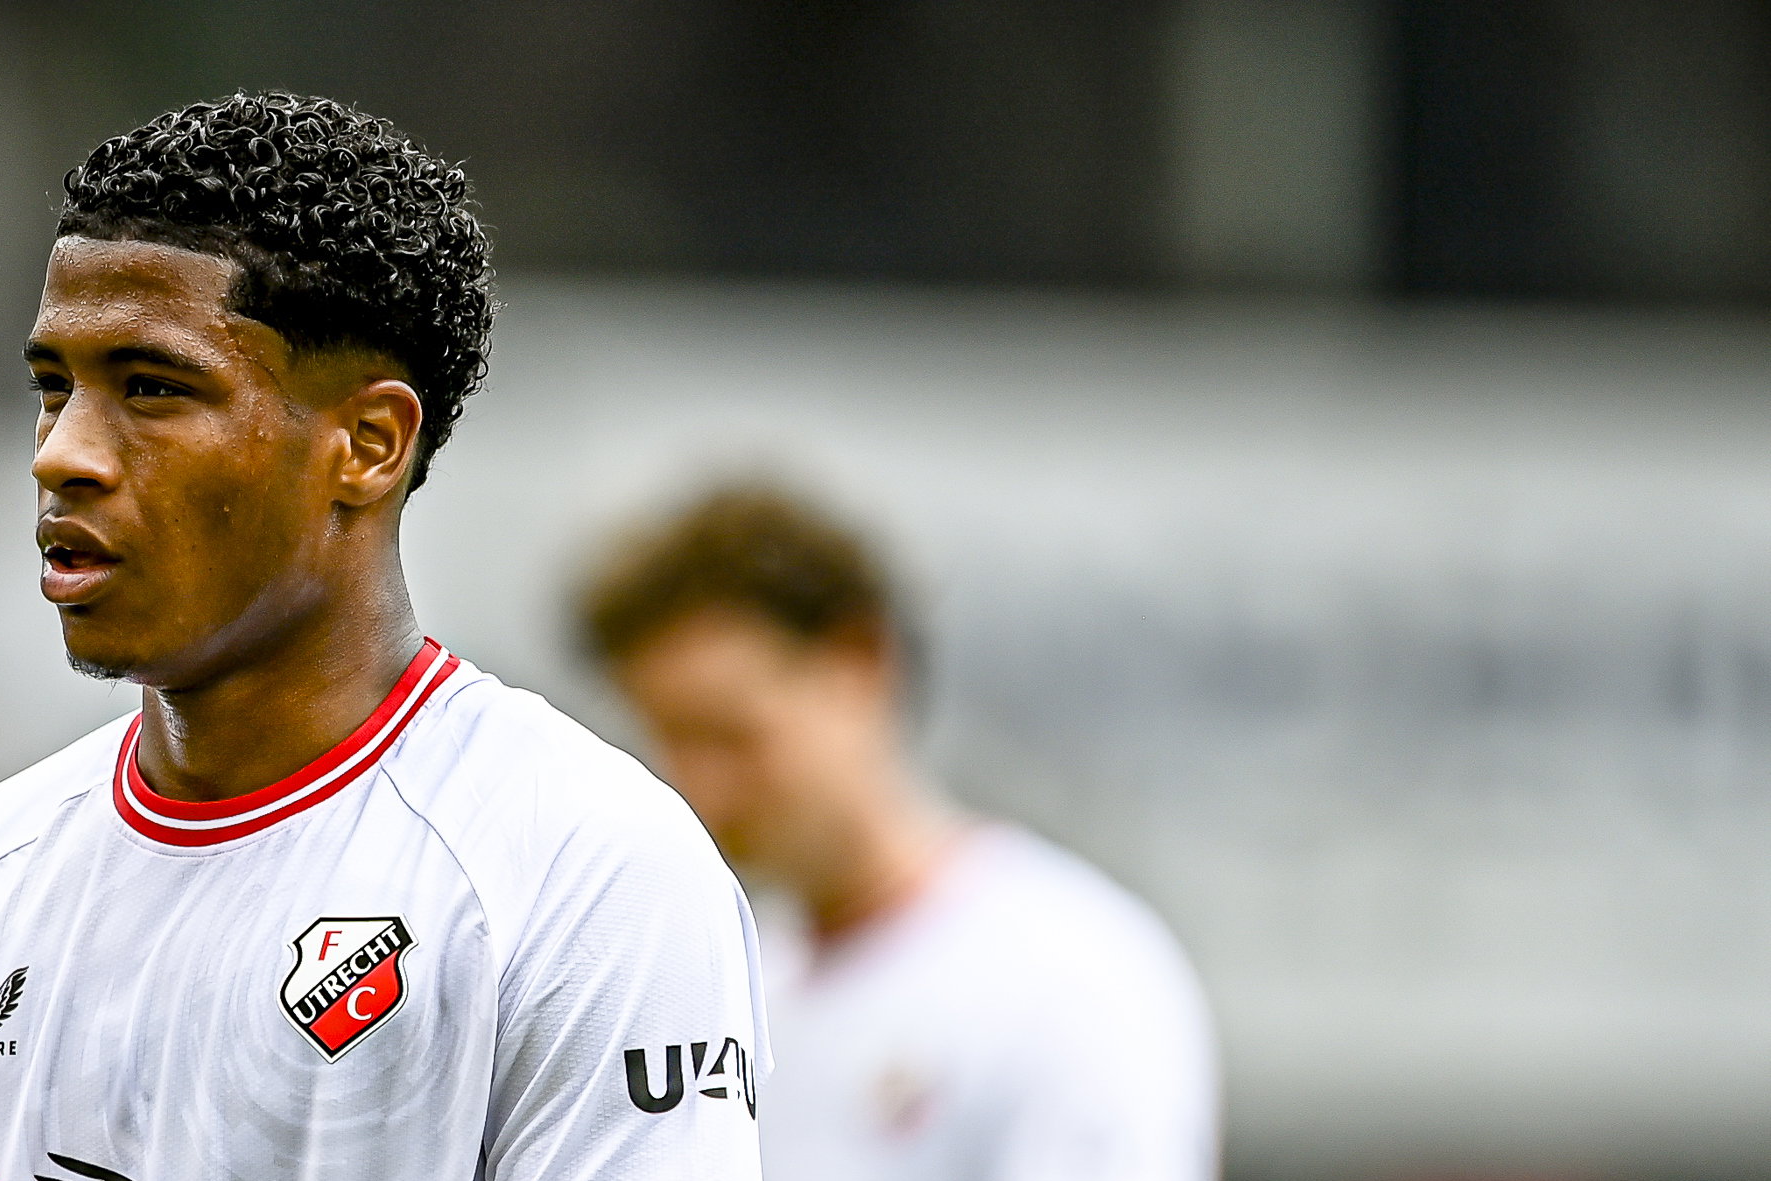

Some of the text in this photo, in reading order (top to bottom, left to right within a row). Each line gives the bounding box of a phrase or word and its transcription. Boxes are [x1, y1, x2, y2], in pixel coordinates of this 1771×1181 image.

[317, 930, 343, 961] F
[292, 924, 402, 1025] UTRECHT
[346, 985, 377, 1021] C
